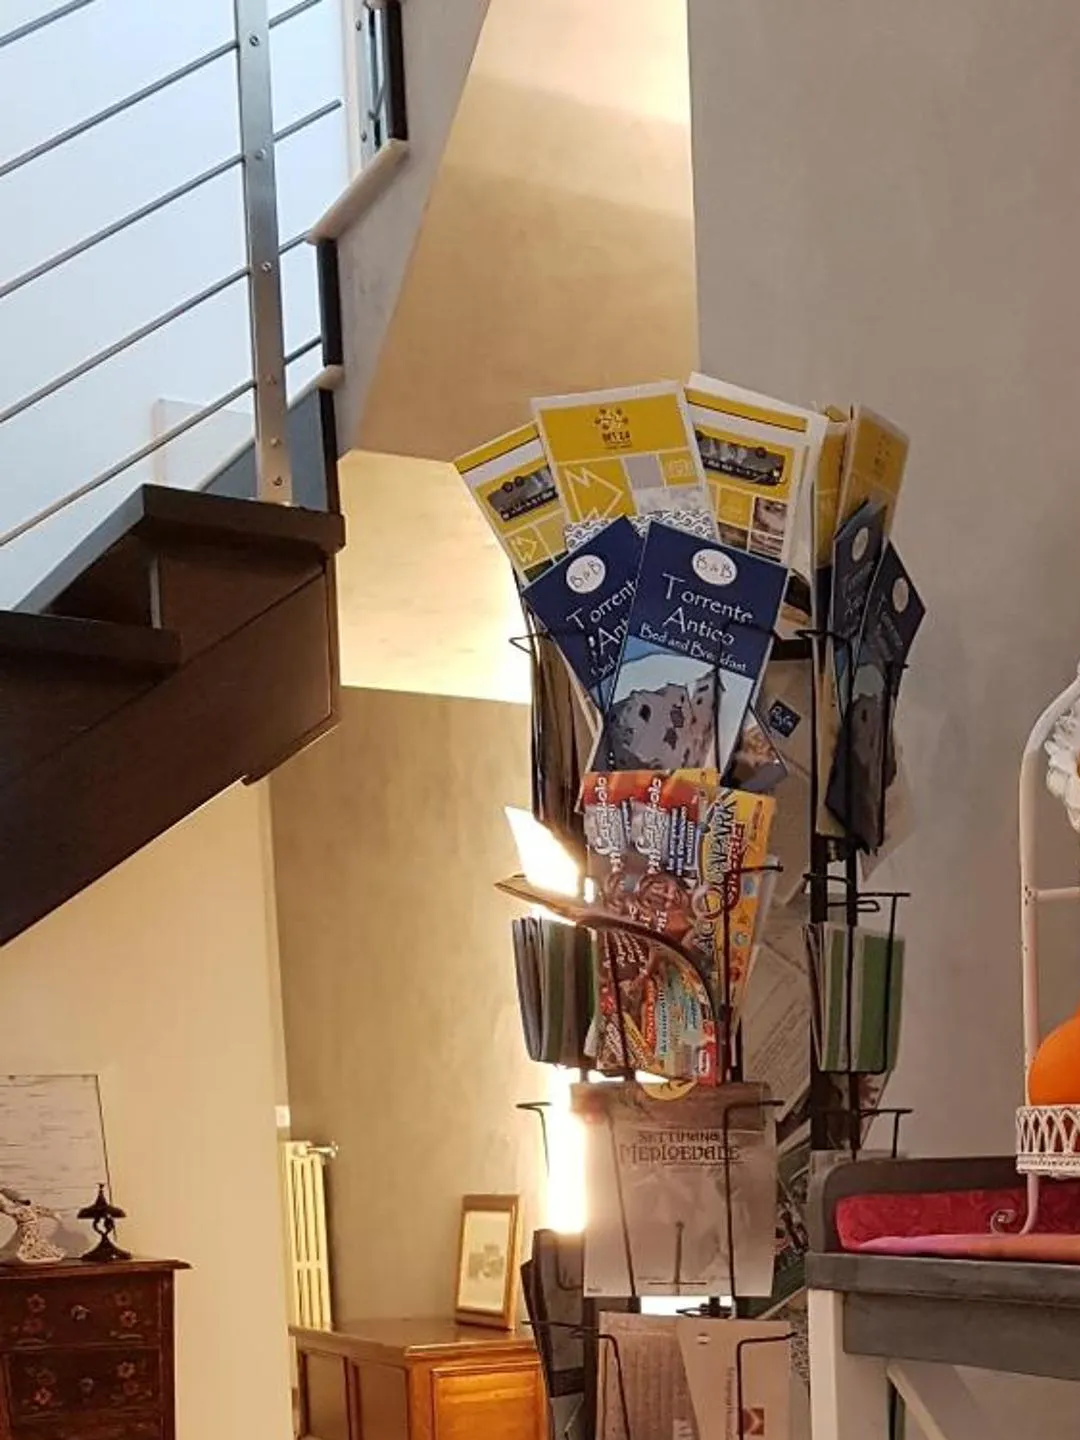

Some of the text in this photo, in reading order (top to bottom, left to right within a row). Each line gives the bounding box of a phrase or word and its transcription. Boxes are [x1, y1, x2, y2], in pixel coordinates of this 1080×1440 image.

[566, 577, 637, 630] Torrent
[662, 572, 754, 625] Torrente
[639, 621, 668, 645] Bed
[668, 635, 691, 652] and
[662, 606, 735, 647] Antico
